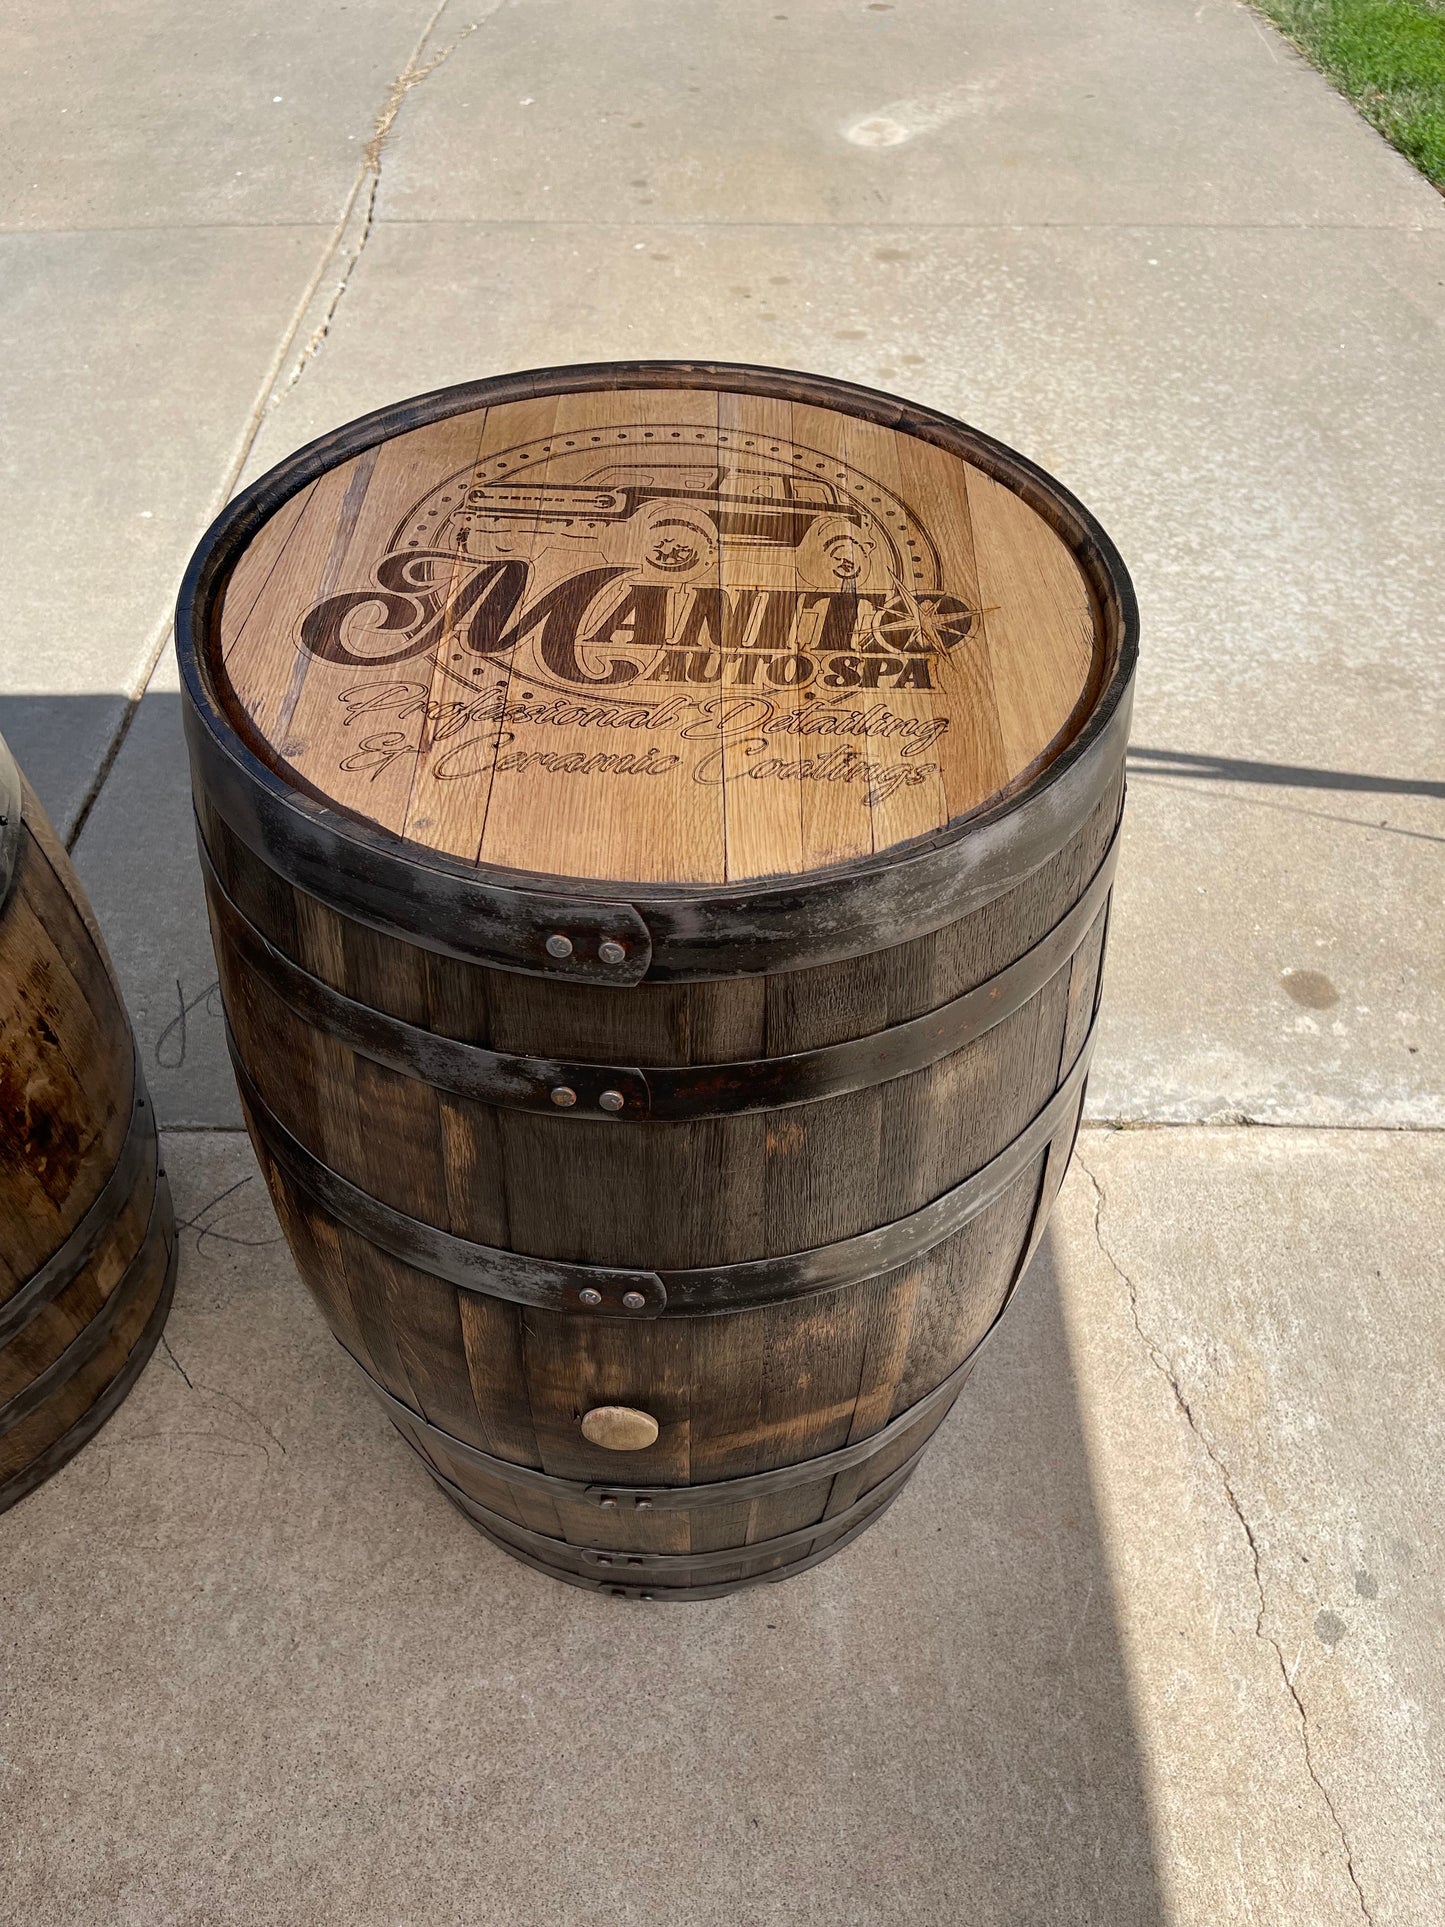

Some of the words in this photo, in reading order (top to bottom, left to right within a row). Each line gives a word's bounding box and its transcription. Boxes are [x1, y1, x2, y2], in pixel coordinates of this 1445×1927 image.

[643, 650, 813, 687] AUTO
[823, 655, 936, 690] SPA
[338, 681, 688, 741] Professional
[680, 694, 950, 757] Detailing
[338, 732, 424, 782] &
[432, 731, 684, 780] Ceramic
[692, 738, 938, 806] Coatings
